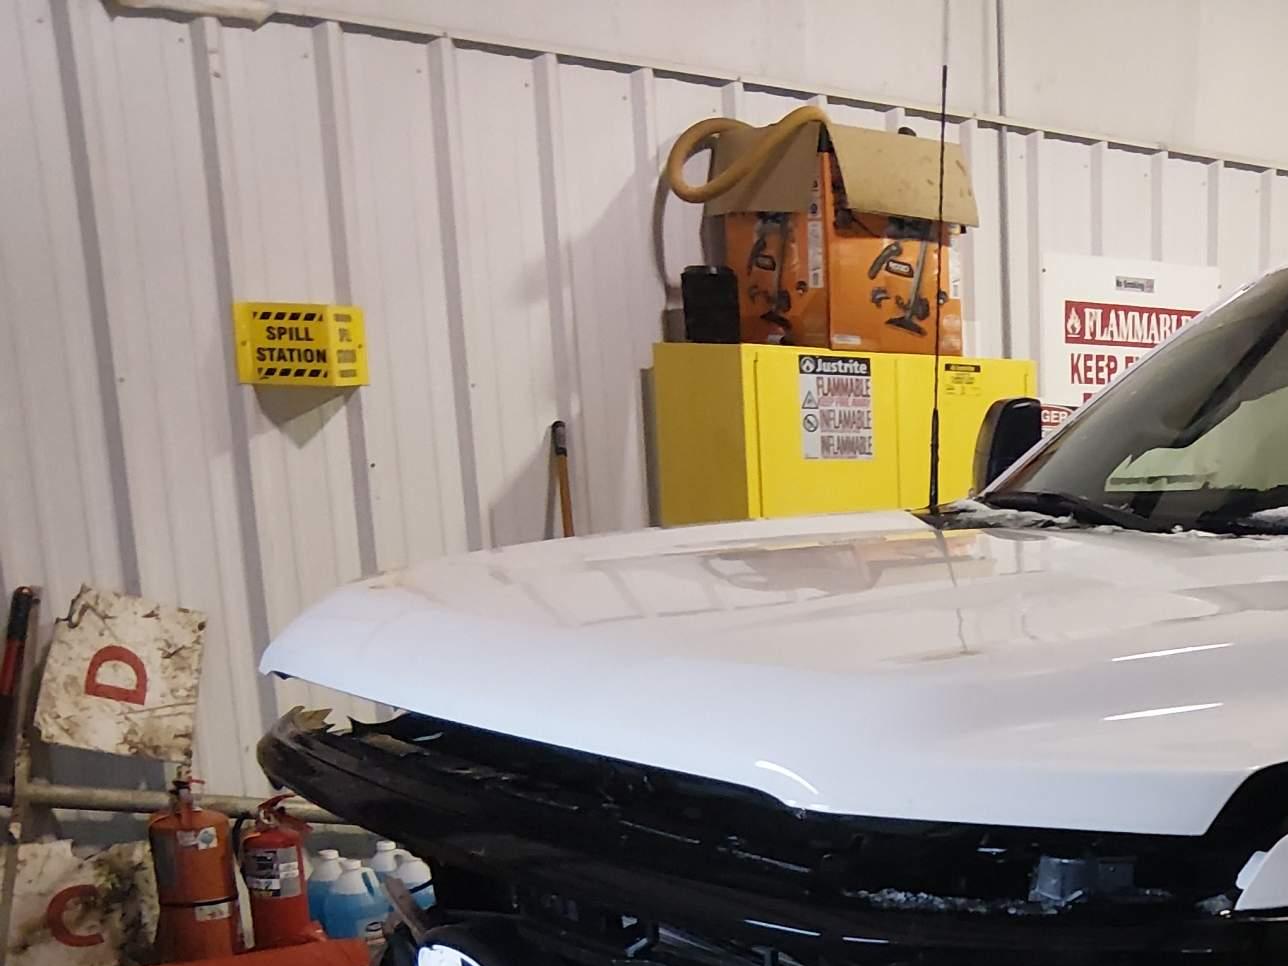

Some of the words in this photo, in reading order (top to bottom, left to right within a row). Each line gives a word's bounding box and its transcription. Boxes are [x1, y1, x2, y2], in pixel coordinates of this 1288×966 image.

[265, 326, 314, 342] SPILL
[255, 346, 328, 363] STATION
[815, 356, 868, 374] Justrite
[1070, 353, 1118, 385] KEEP
[84, 644, 148, 706] D
[46, 884, 105, 948] C
